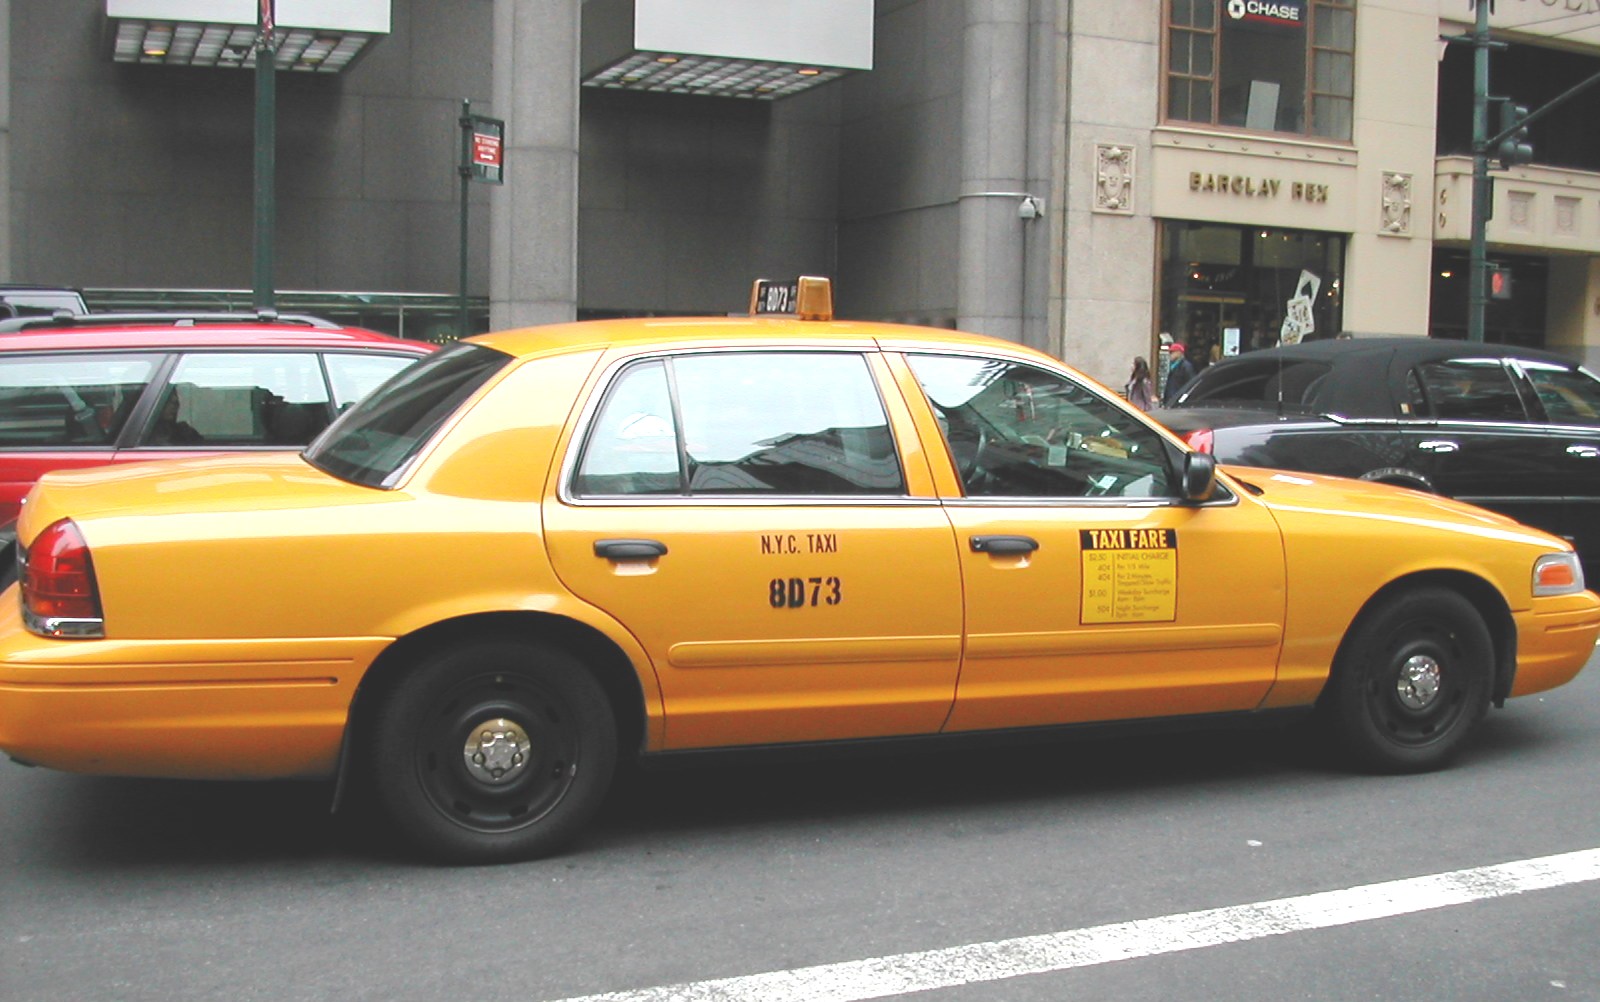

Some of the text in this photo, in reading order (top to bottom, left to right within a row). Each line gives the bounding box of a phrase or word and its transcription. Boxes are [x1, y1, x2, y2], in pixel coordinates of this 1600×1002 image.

[1247, 1, 1299, 20] CHASE
[1189, 171, 1328, 203] BARCLAY REX
[761, 533, 837, 554] N.Y.C. TAXI
[1089, 529, 1167, 549] TAXI FARE
[769, 577, 841, 609] 8D73
